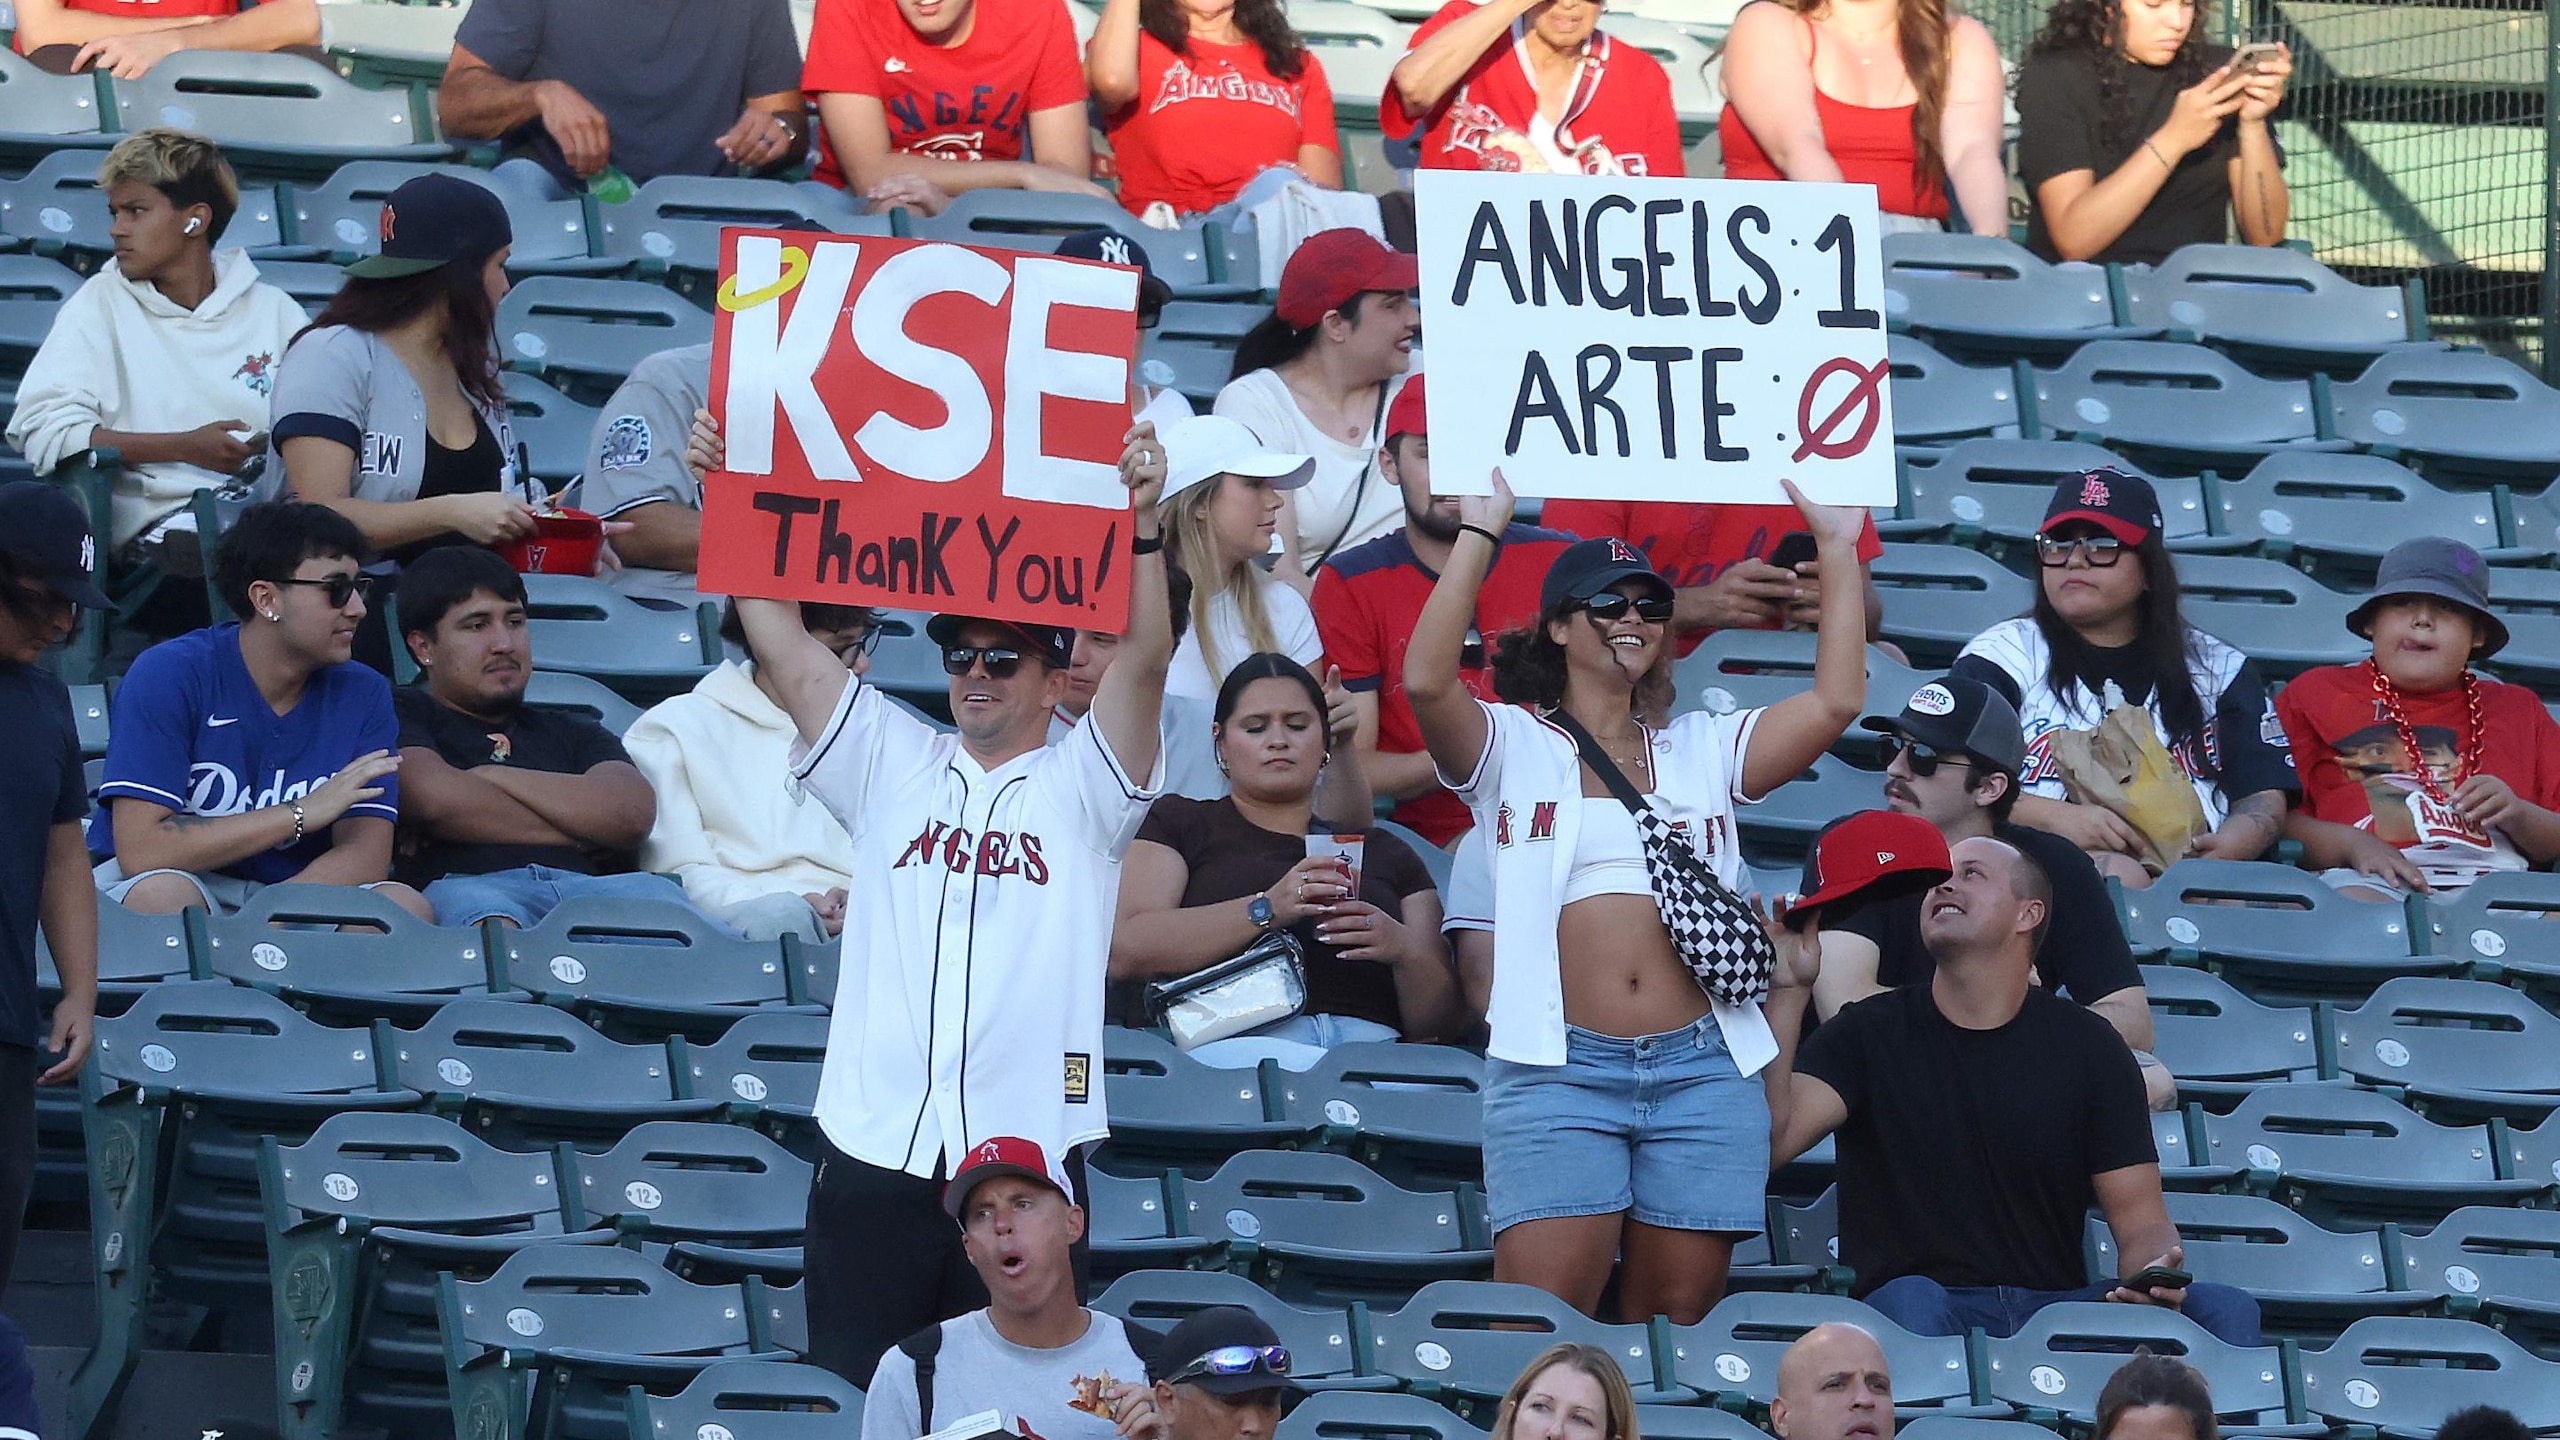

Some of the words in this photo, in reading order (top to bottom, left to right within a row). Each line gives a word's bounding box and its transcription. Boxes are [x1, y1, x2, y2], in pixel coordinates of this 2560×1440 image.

[725, 235, 1139, 509] KSE
[2080, 475, 2110, 506] LA
[976, 514, 1116, 611] You!
[262, 949, 278, 965] 12
[562, 962, 575, 979] 11
[449, 1064, 463, 1081] 12
[745, 1080, 757, 1096] 11
[333, 1179, 348, 1196] 13
[636, 1188, 651, 1205] 12
[1728, 1360, 1738, 1377] 9
[2357, 1387, 2367, 1403] 7
